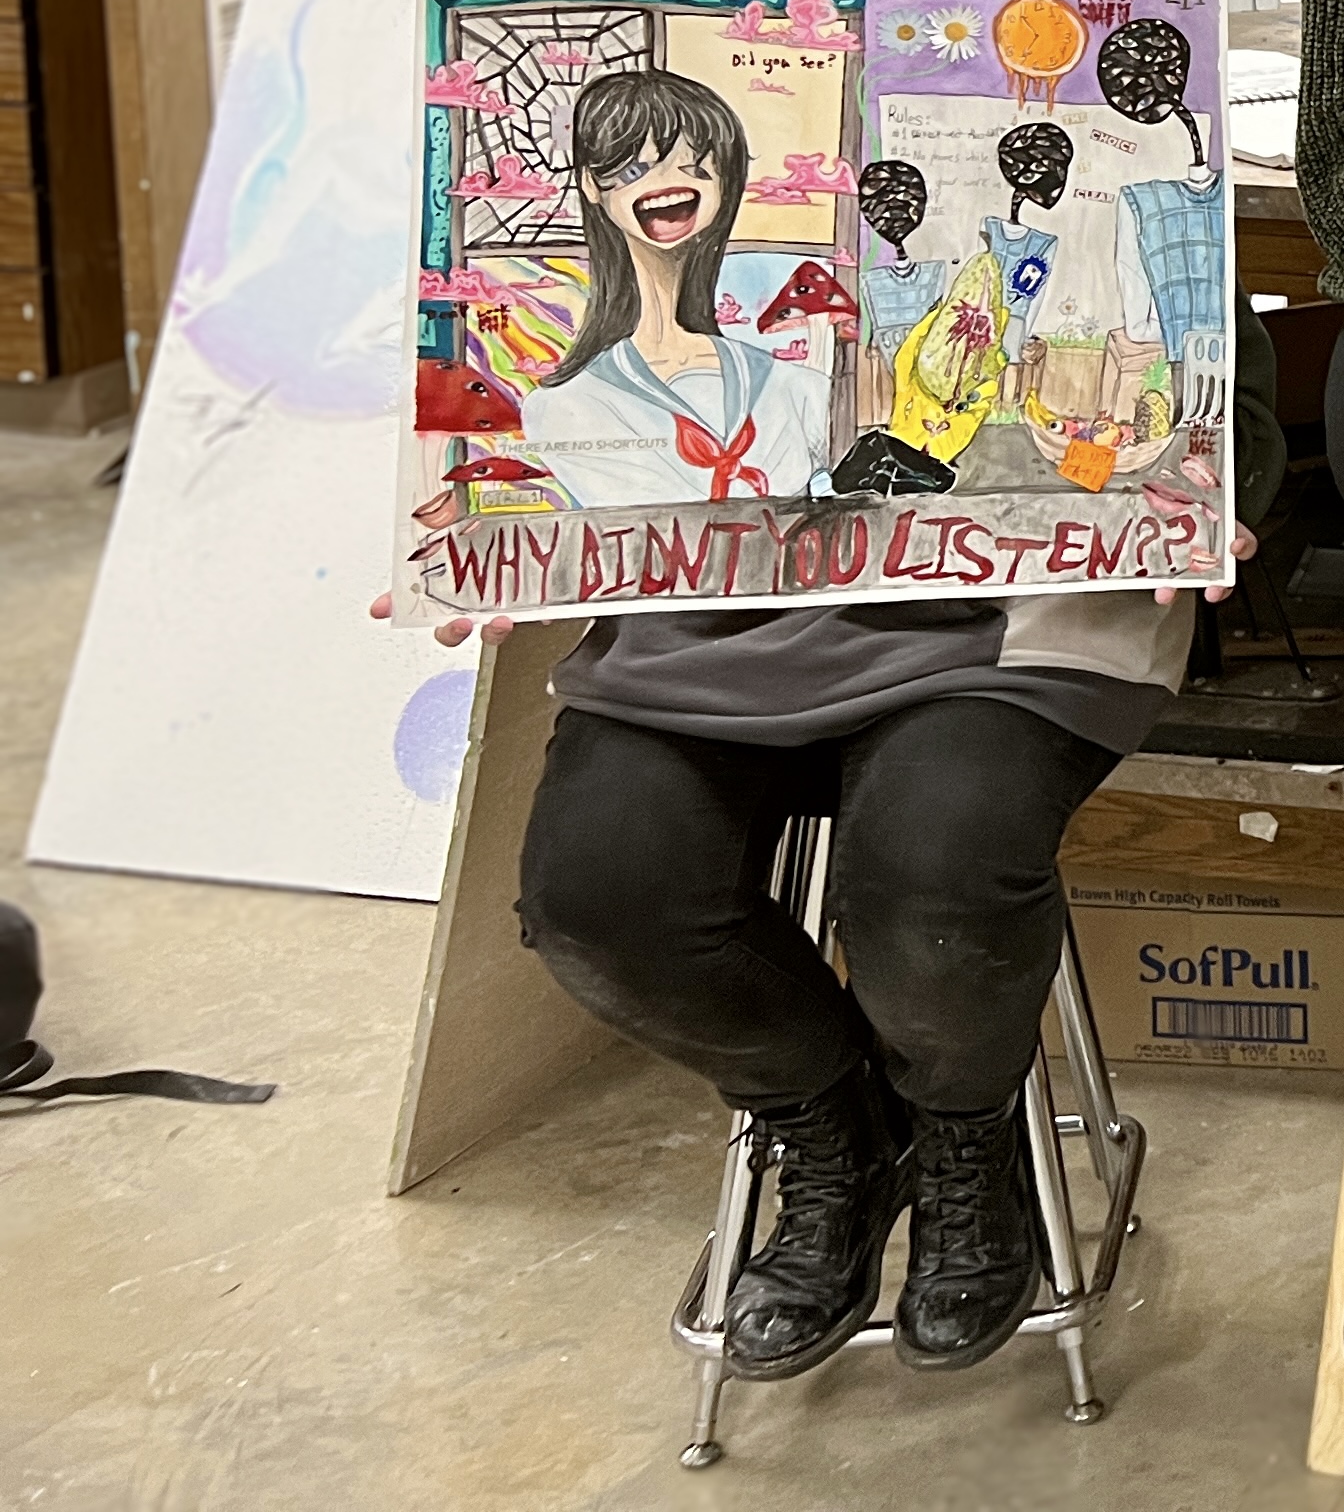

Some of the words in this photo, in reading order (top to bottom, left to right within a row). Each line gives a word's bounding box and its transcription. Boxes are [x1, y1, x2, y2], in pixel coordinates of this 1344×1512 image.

[732, 50, 755, 68] Did
[762, 58, 791, 74] you
[888, 104, 931, 126] Rules:
[1090, 128, 1138, 155] CHOICE
[500, 441, 541, 454] THERE
[543, 440, 570, 453] ARE
[571, 439, 593, 451] NO
[596, 437, 669, 450] SHORTCUTS
[447, 520, 560, 606] WHY
[761, 509, 868, 594] YOU
[883, 509, 1197, 586] LISTEN??
[1070, 886, 1112, 901] Brown
[1114, 889, 1147, 905] High
[1149, 890, 1204, 908] Capacity
[1207, 894, 1233, 907] Roll
[1236, 894, 1281, 908] Towels
[1138, 943, 1312, 990] SofPull
